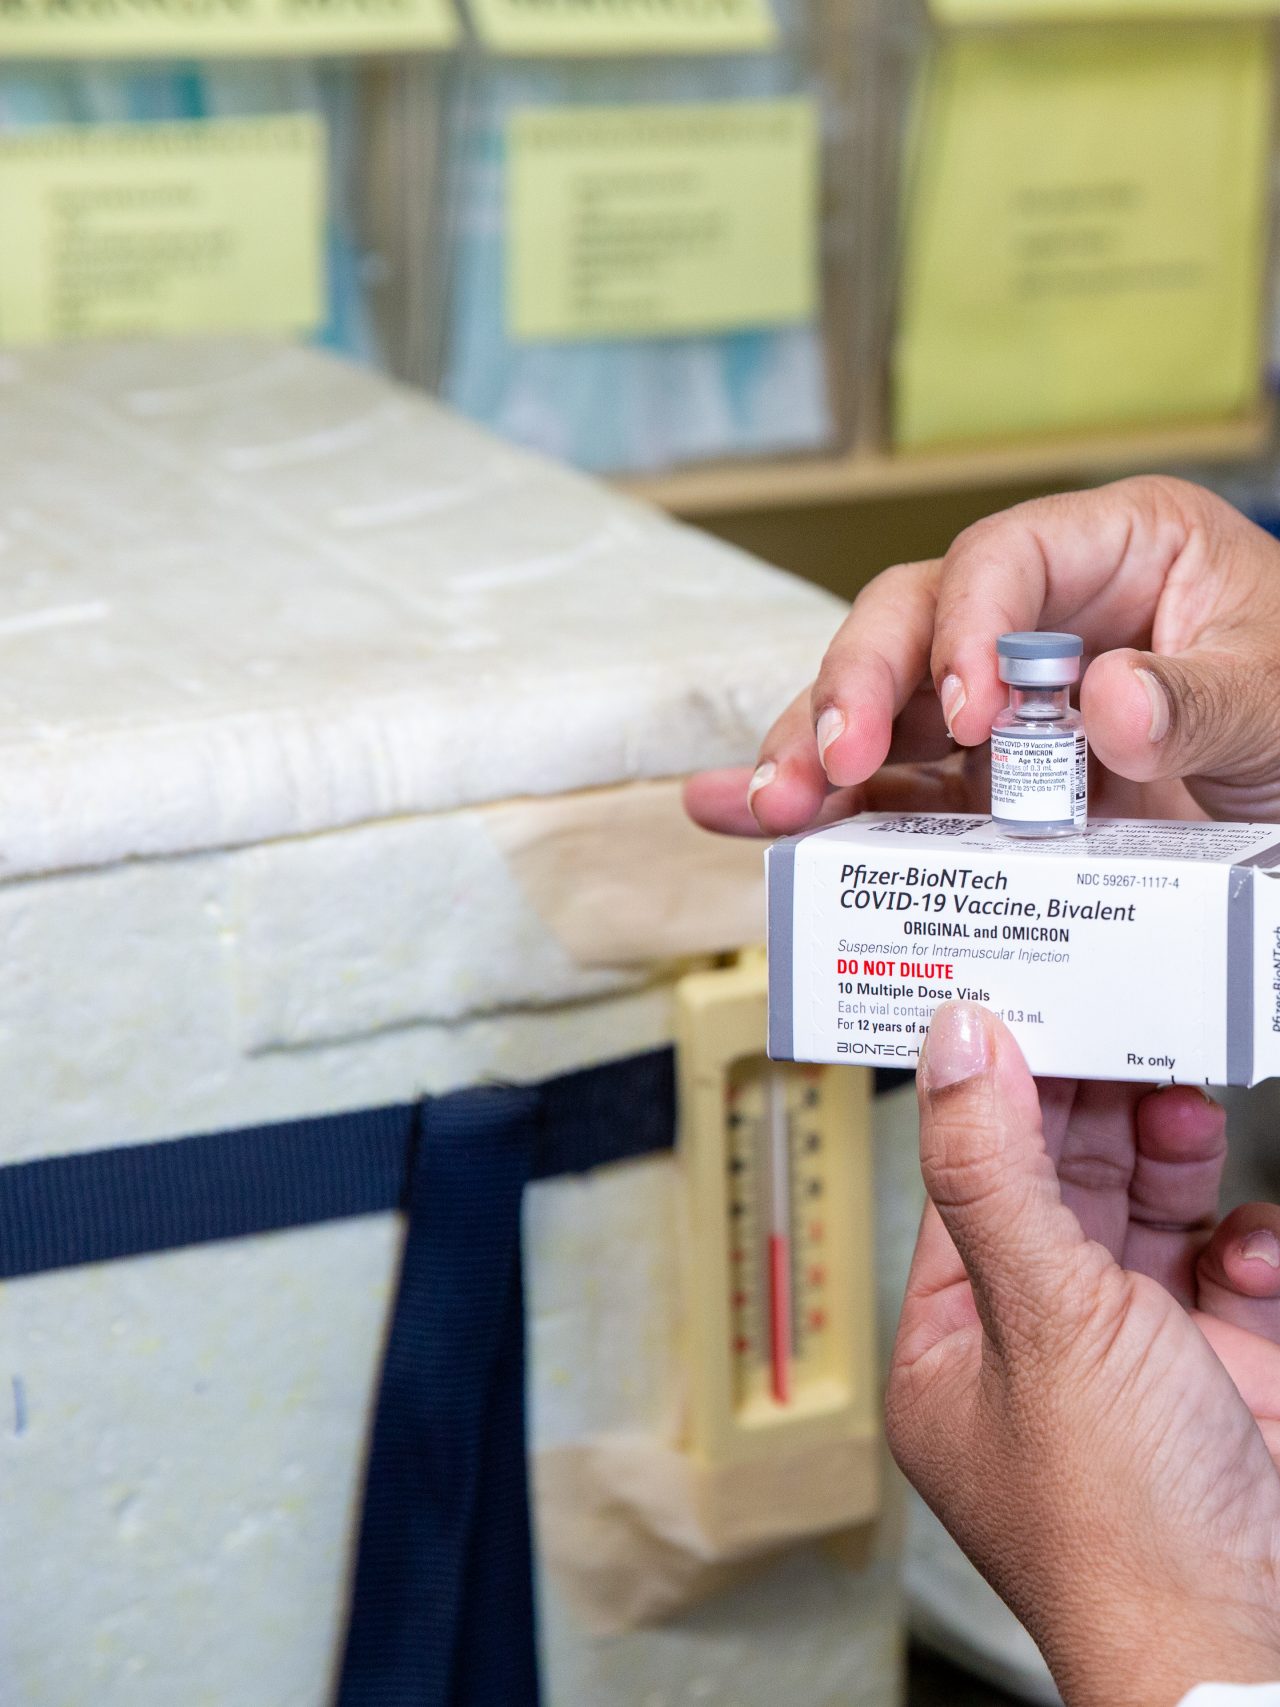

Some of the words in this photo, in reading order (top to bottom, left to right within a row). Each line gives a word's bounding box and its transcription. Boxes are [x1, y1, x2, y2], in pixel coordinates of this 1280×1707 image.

[840, 864, 1008, 890] Pfizer-BioNTech
[1076, 873, 1100, 886] NDC
[1103, 874, 1180, 889] 59267-1117-4
[840, 889, 947, 913] COVID-19
[953, 894, 1041, 921] Vaccine,
[1047, 898, 1136, 922] Bivalent
[903, 921, 970, 937] ORIGINAL
[974, 925, 998, 939] and
[1002, 926, 1070, 942] OMICRON
[837, 939, 908, 957] Suspension
[912, 943, 928, 956] for
[932, 944, 1014, 960] Intramuscular
[1018, 949, 1070, 964] Injection
[837, 959, 858, 975] DO
[863, 960, 895, 977] NOT
[900, 962, 954, 980] DILUTE
[838, 982, 853, 994] 10
[857, 983, 914, 999] Multiple
[918, 986, 952, 999] Dose
[956, 987, 990, 1001] Vials
[838, 1000, 866, 1014] Each
[869, 1002, 890, 1015] vial
[1007, 1009, 1024, 1022] 0.3
[1027, 1011, 1045, 1024] mL
[837, 1018, 854, 1030] For
[858, 1019, 870, 1031] 12
[872, 1022, 902, 1035] years
[905, 1021, 916, 1033] of
[836, 1042, 920, 1057] BIONTECH
[1127, 1053, 1144, 1065] Rx
[1148, 1055, 1176, 1069] only
